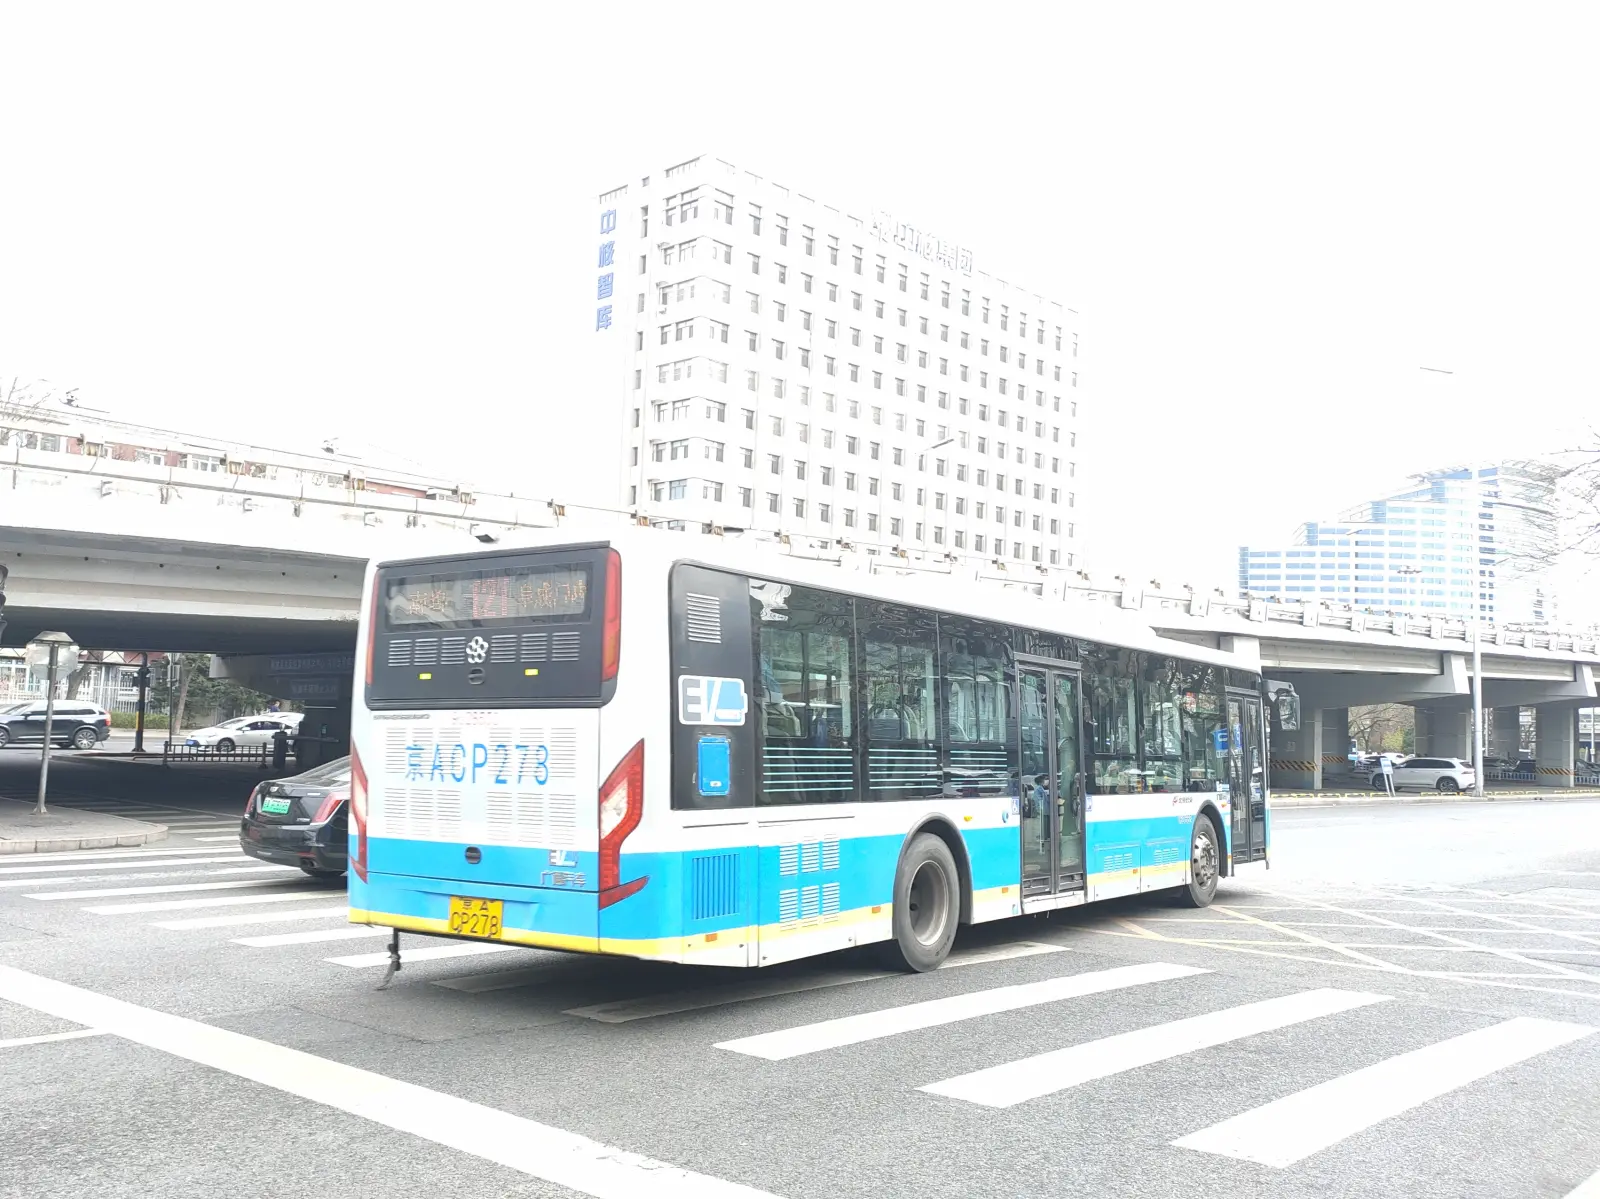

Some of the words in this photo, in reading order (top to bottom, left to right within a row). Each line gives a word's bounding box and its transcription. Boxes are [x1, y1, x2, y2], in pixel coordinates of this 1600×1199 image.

[596, 209, 617, 333] 中核智库
[451, 911, 499, 936] CP278
